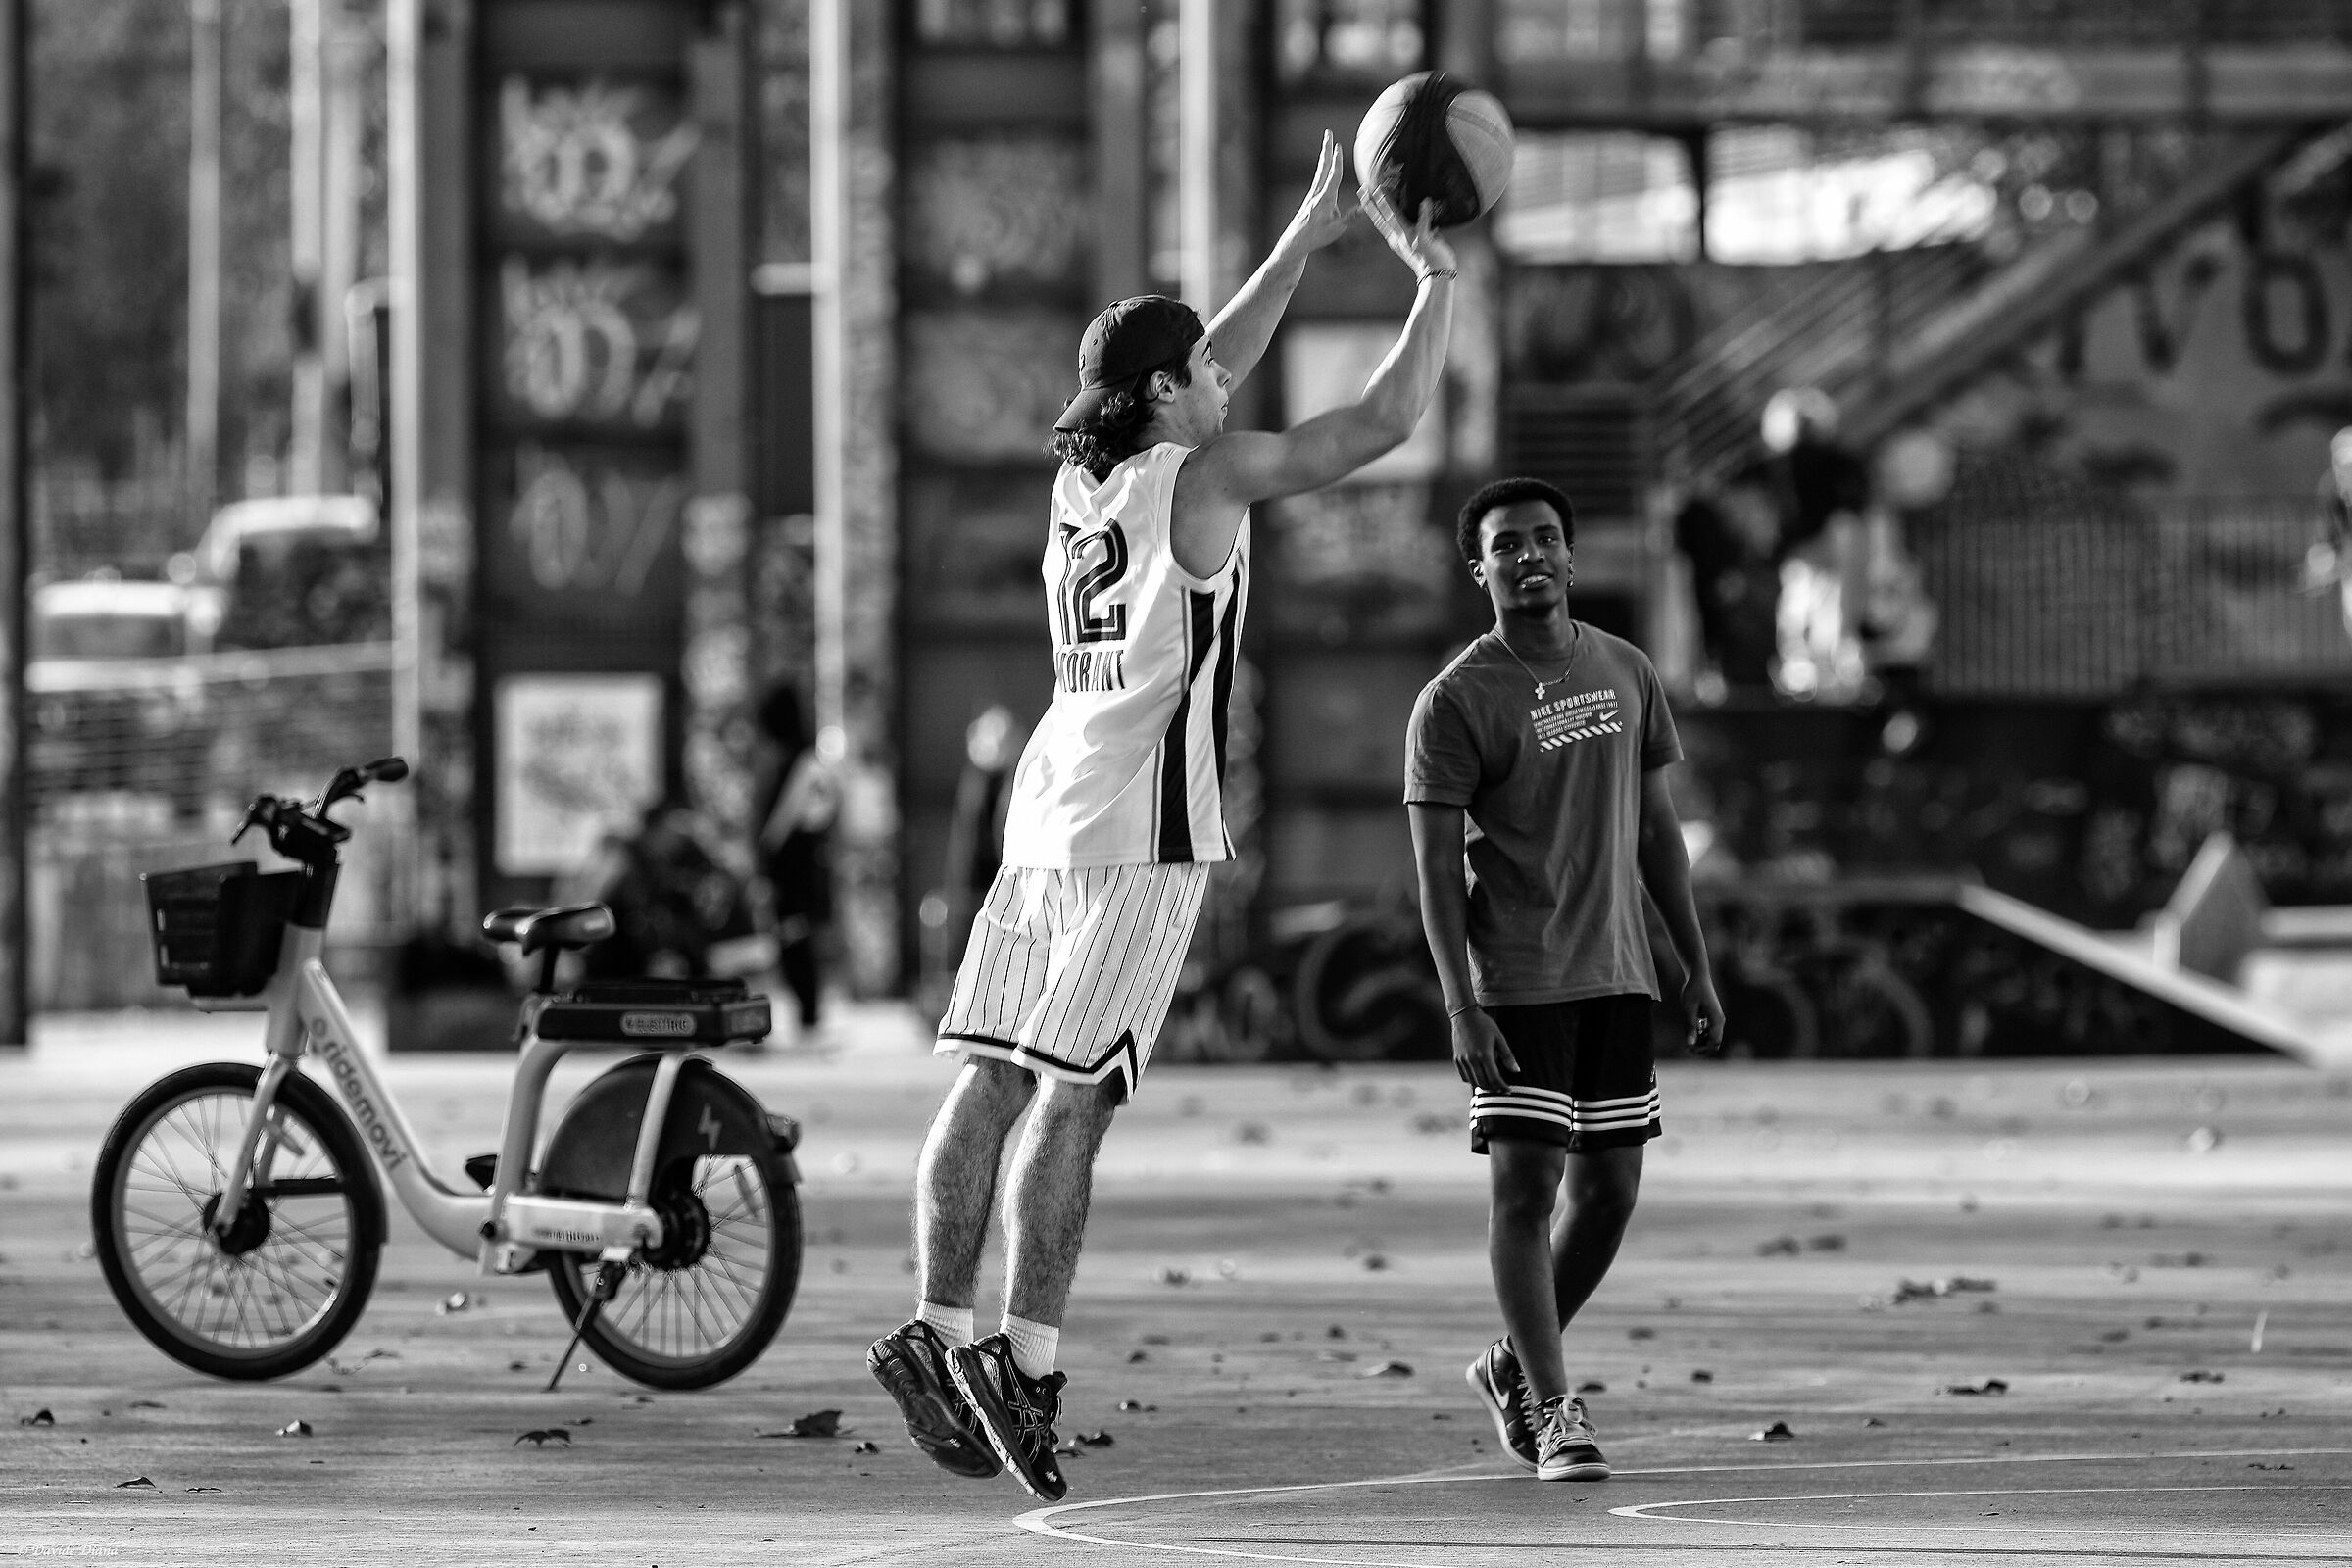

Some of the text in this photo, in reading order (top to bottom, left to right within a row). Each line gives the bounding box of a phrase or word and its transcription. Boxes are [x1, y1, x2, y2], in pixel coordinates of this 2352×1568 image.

[1530, 704, 1553, 721] NIKE
[1553, 689, 1616, 712] SPORTSWEAR
[322, 1041, 408, 1171] ridemovi
